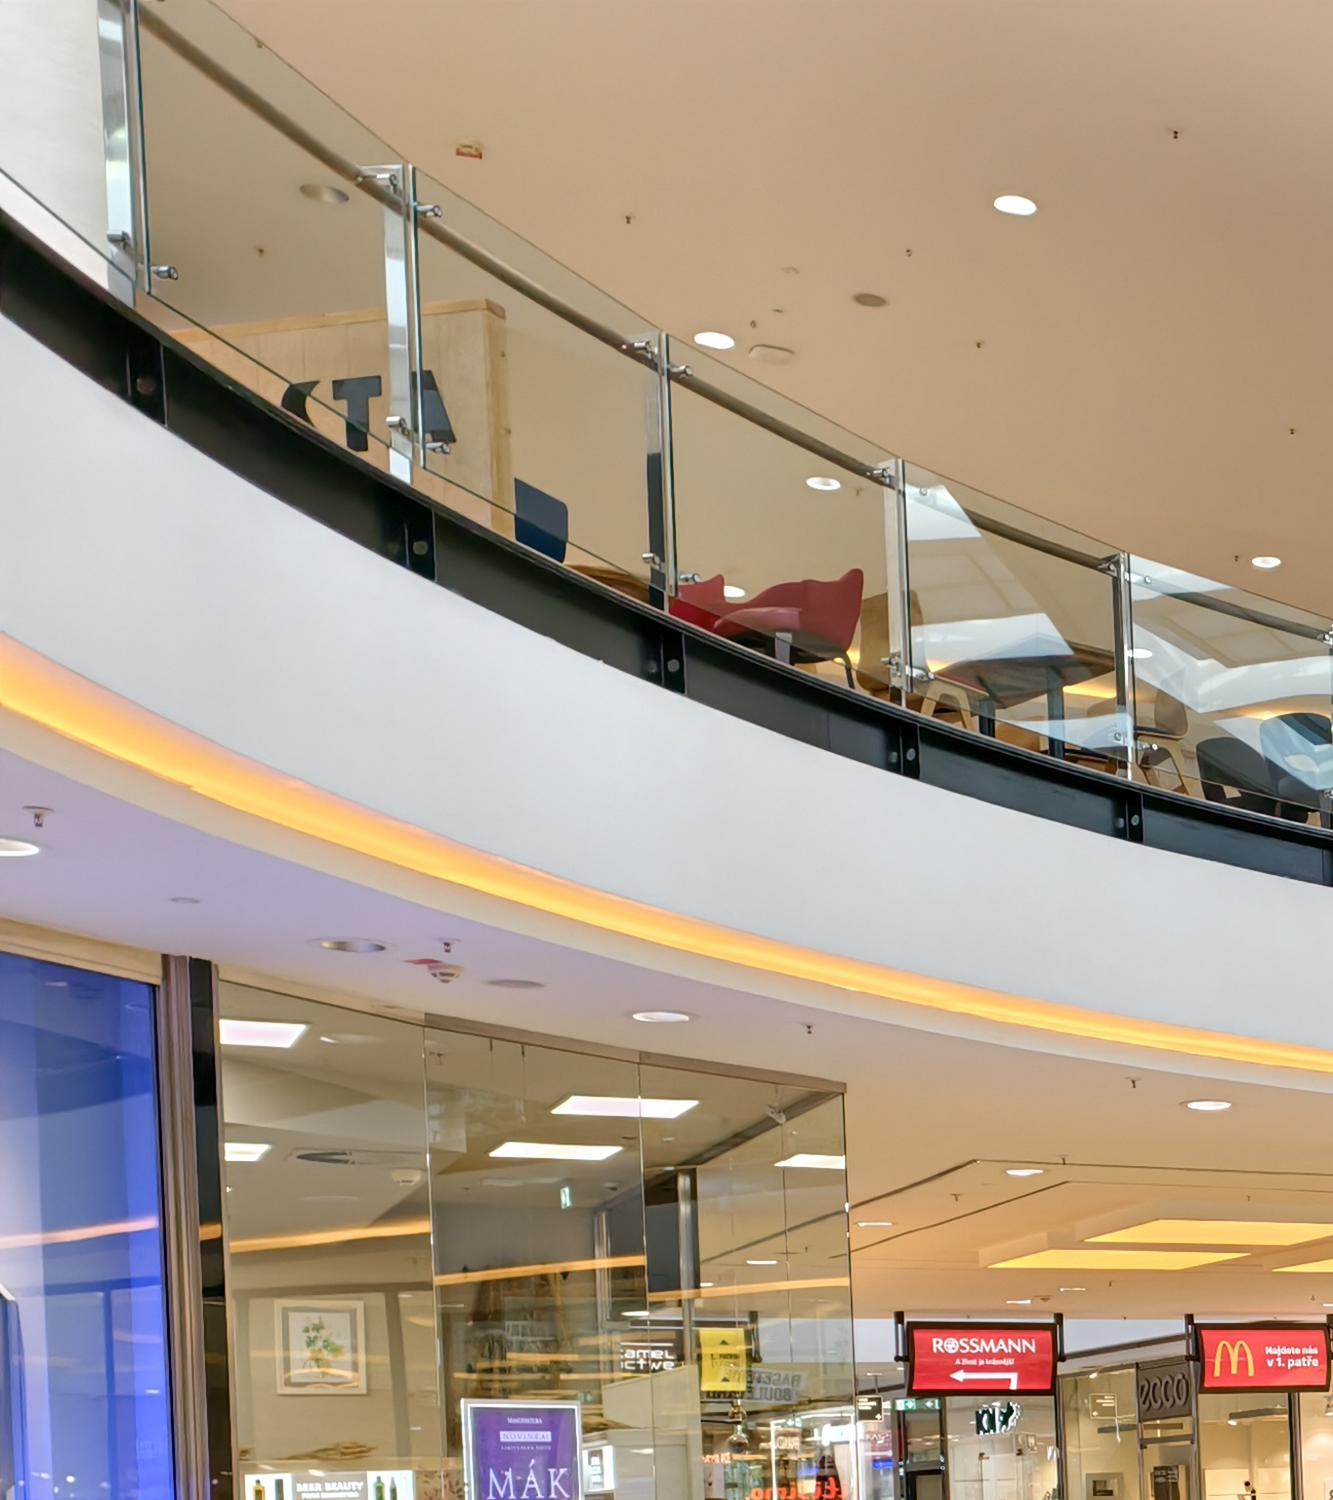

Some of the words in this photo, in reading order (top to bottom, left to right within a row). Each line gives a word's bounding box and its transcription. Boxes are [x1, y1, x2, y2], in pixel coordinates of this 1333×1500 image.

[932, 1337, 1036, 1354] ROSSMANN
[1265, 1345, 1300, 1356] Najdete
[1301, 1345, 1319, 1355] nás
[1266, 1358, 1274, 1367] v
[1275, 1357, 1286, 1368] 1.
[1287, 1355, 1319, 1370] patře
[295, 1482, 322, 1493] BEER
[324, 1480, 364, 1492] BEAUTY
[486, 1458, 571, 1500] MÁK
